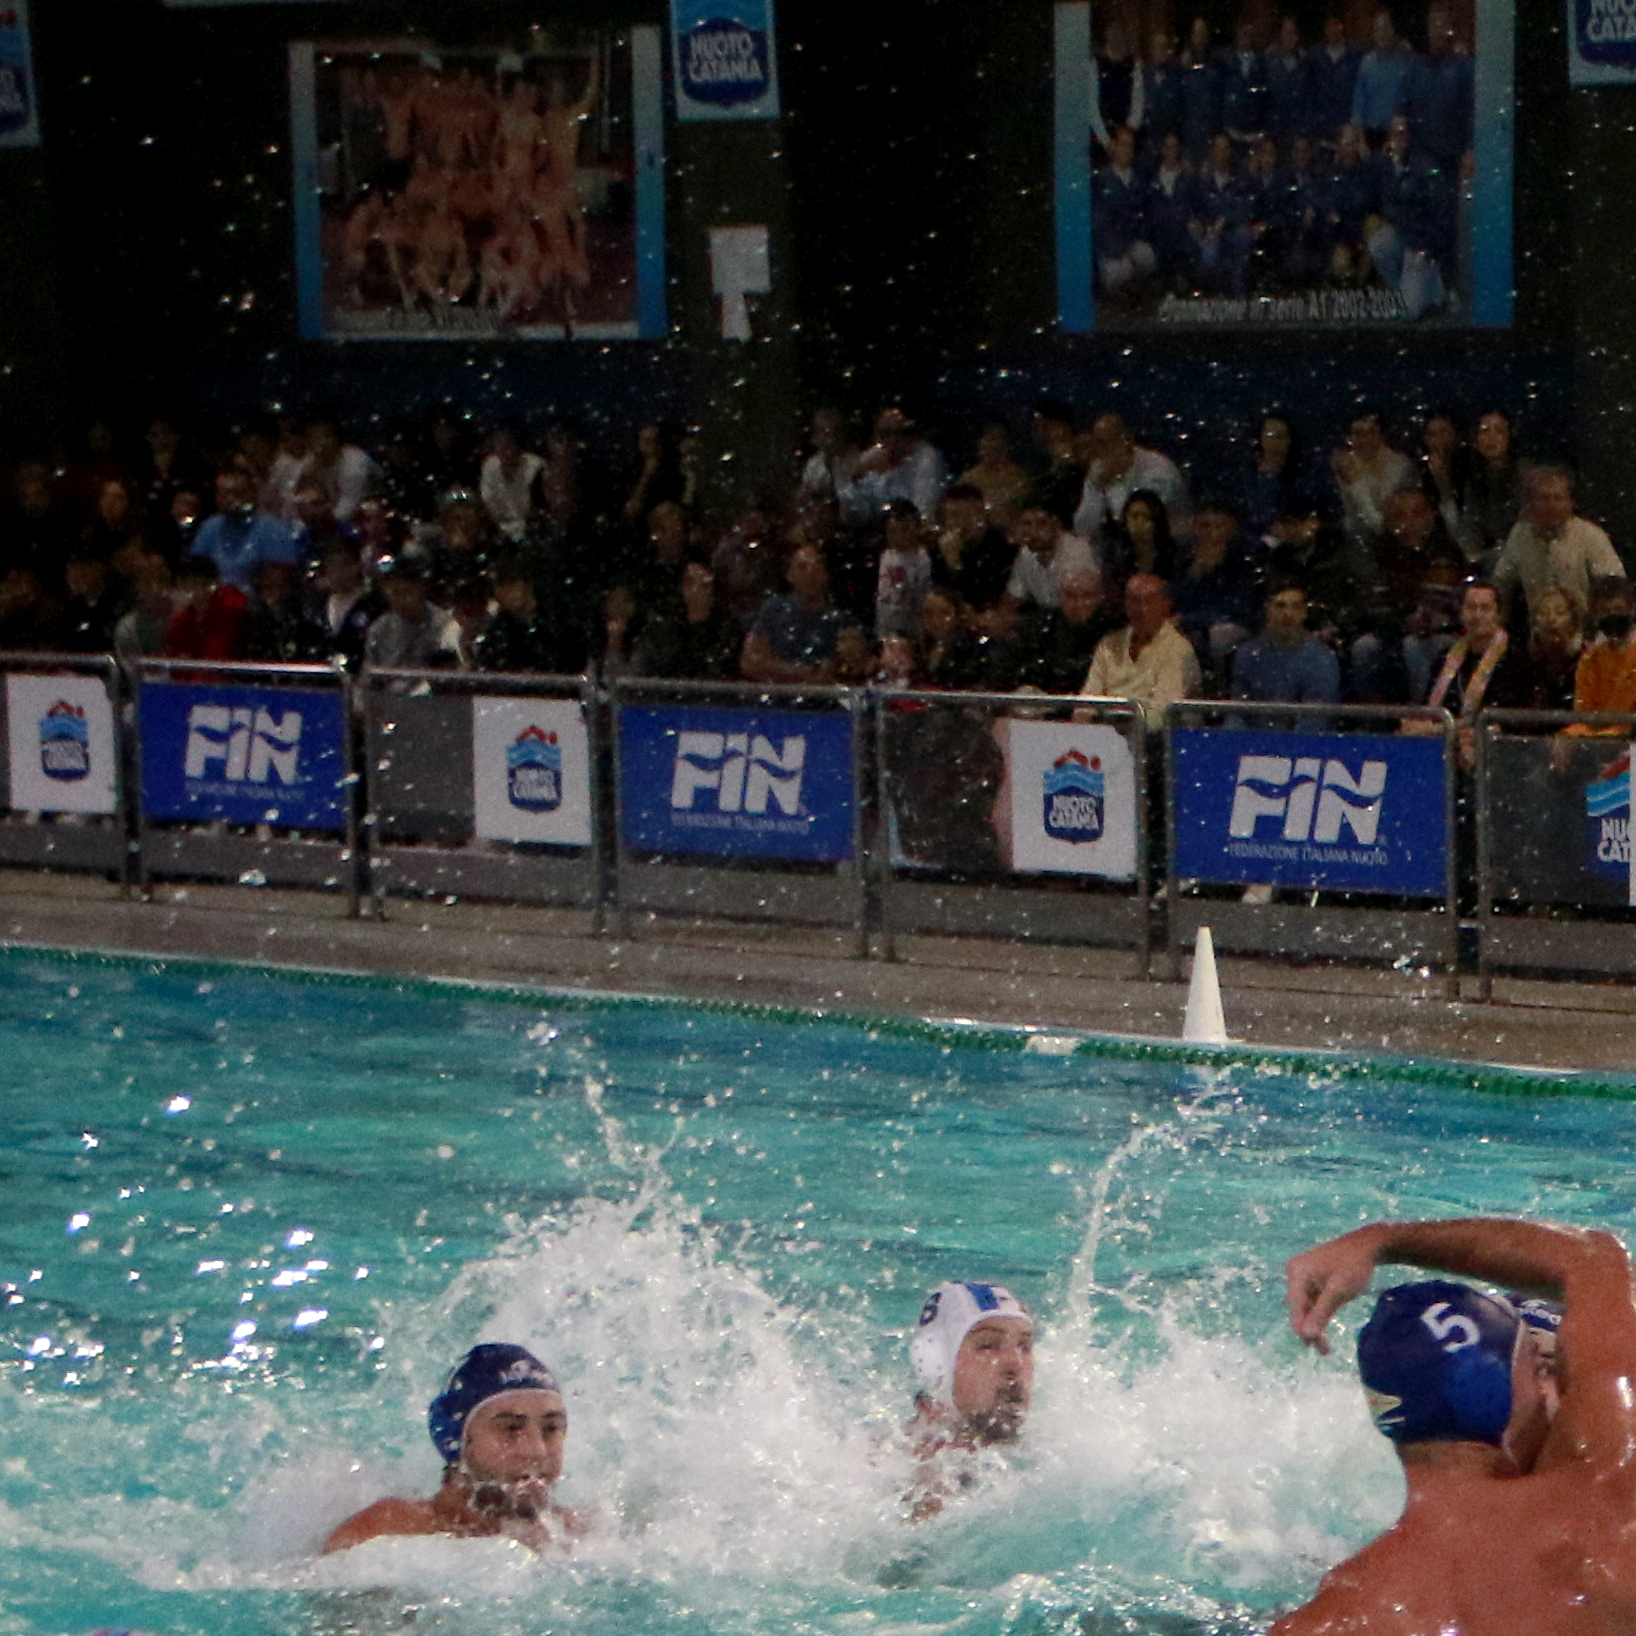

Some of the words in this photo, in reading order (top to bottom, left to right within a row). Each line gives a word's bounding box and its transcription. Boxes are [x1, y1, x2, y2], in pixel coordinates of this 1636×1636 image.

[688, 57, 763, 83] CATANIA
[690, 30, 754, 61] NUOTO
[184, 704, 303, 787] FIN
[671, 731, 806, 816] FIN
[1229, 754, 1388, 846] FIN
[1419, 1301, 1481, 1354] 5
